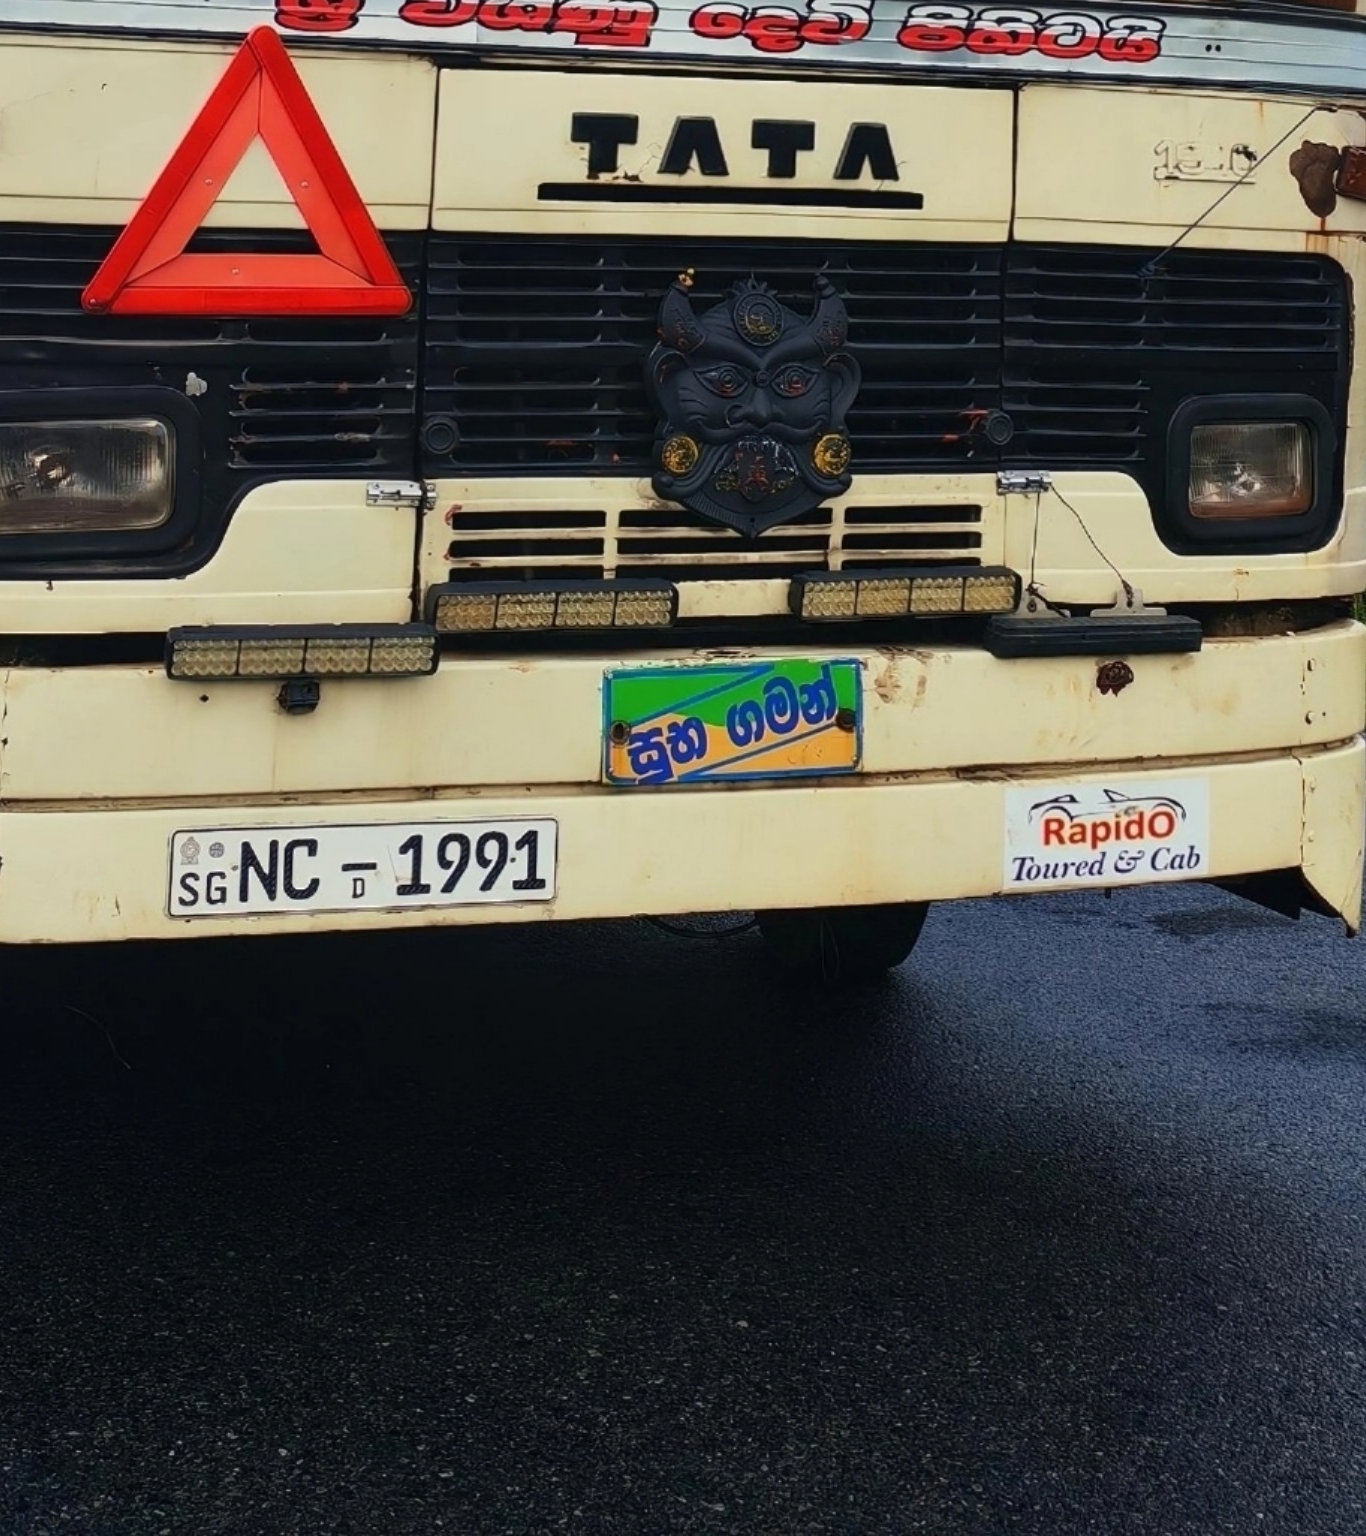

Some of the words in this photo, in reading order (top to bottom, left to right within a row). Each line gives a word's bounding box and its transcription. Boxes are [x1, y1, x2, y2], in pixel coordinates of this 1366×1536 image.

[571, 113, 900, 181] TATA
[178, 870, 227, 907] SG
[239, 837, 320, 903] NC
[396, 830, 546, 897] 1991
[1011, 852, 1107, 882] Toured
[1113, 849, 1145, 874] &
[1150, 845, 1201, 873] Cab
